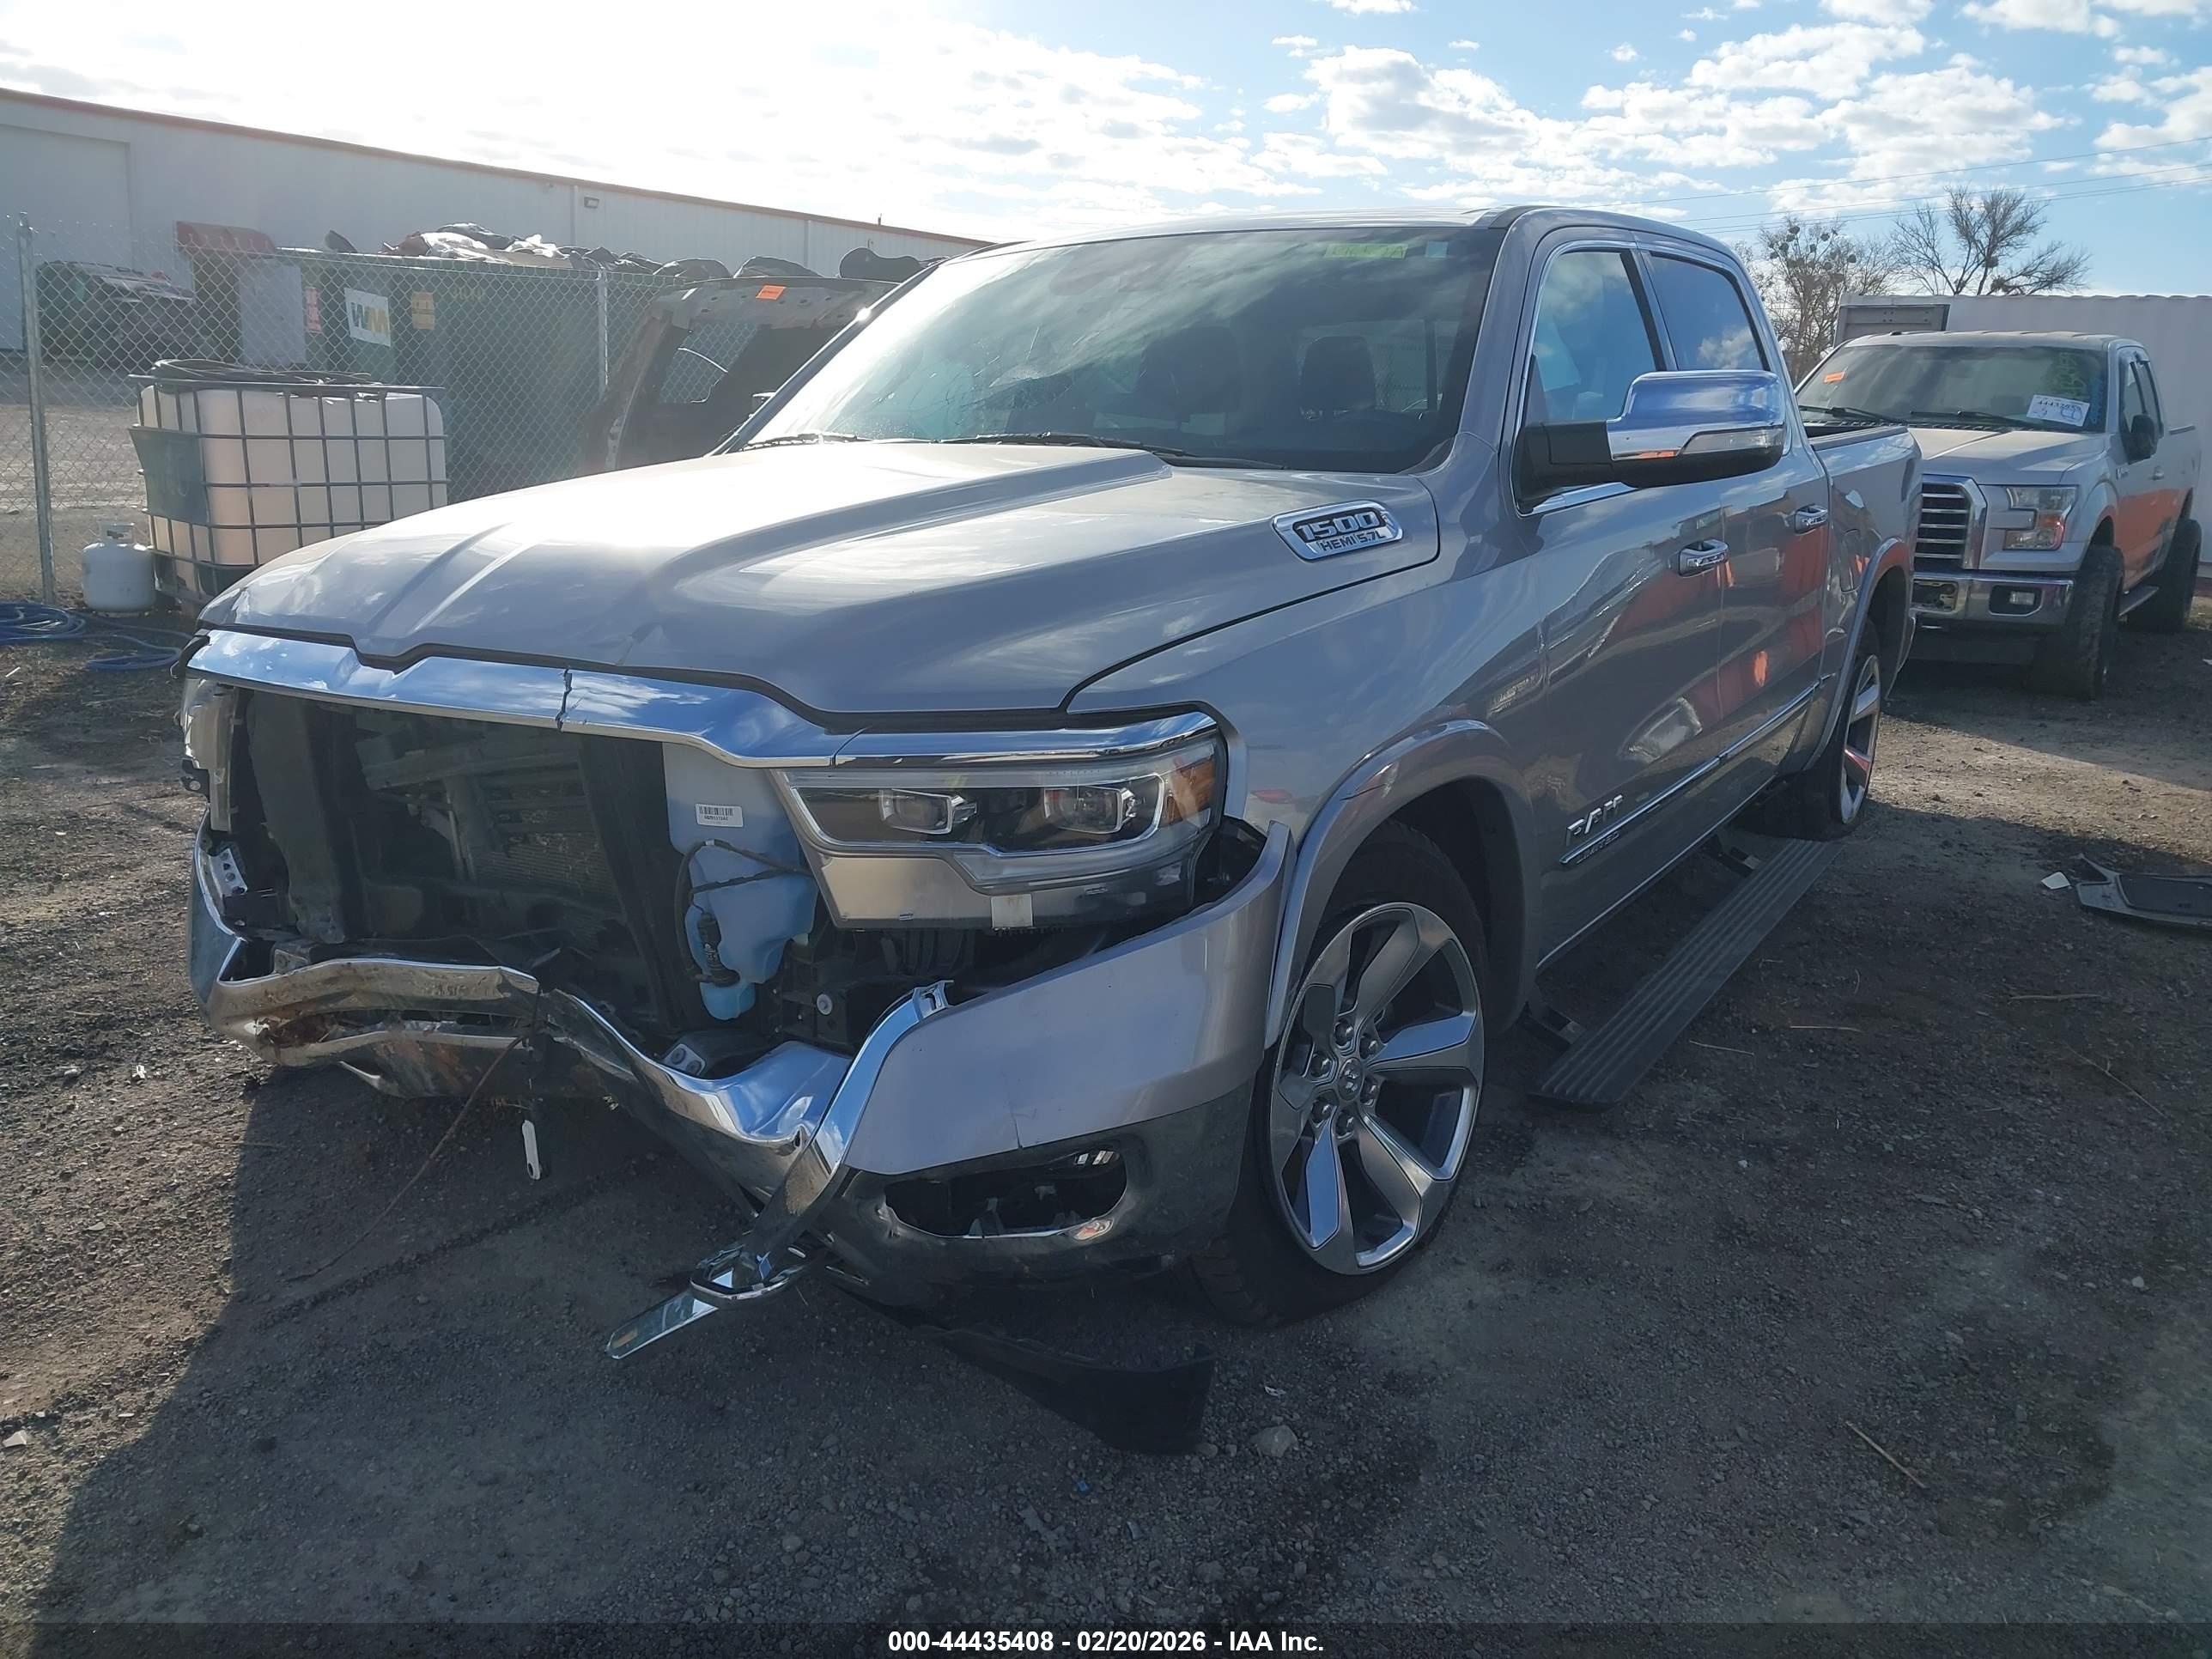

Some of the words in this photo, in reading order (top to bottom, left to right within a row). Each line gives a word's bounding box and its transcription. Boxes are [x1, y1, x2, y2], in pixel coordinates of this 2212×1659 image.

[350, 301, 386, 333] WM
[1297, 511, 1381, 540] 1500
[1322, 536, 1357, 551] HEMI
[1357, 531, 1387, 544] 5.7L
